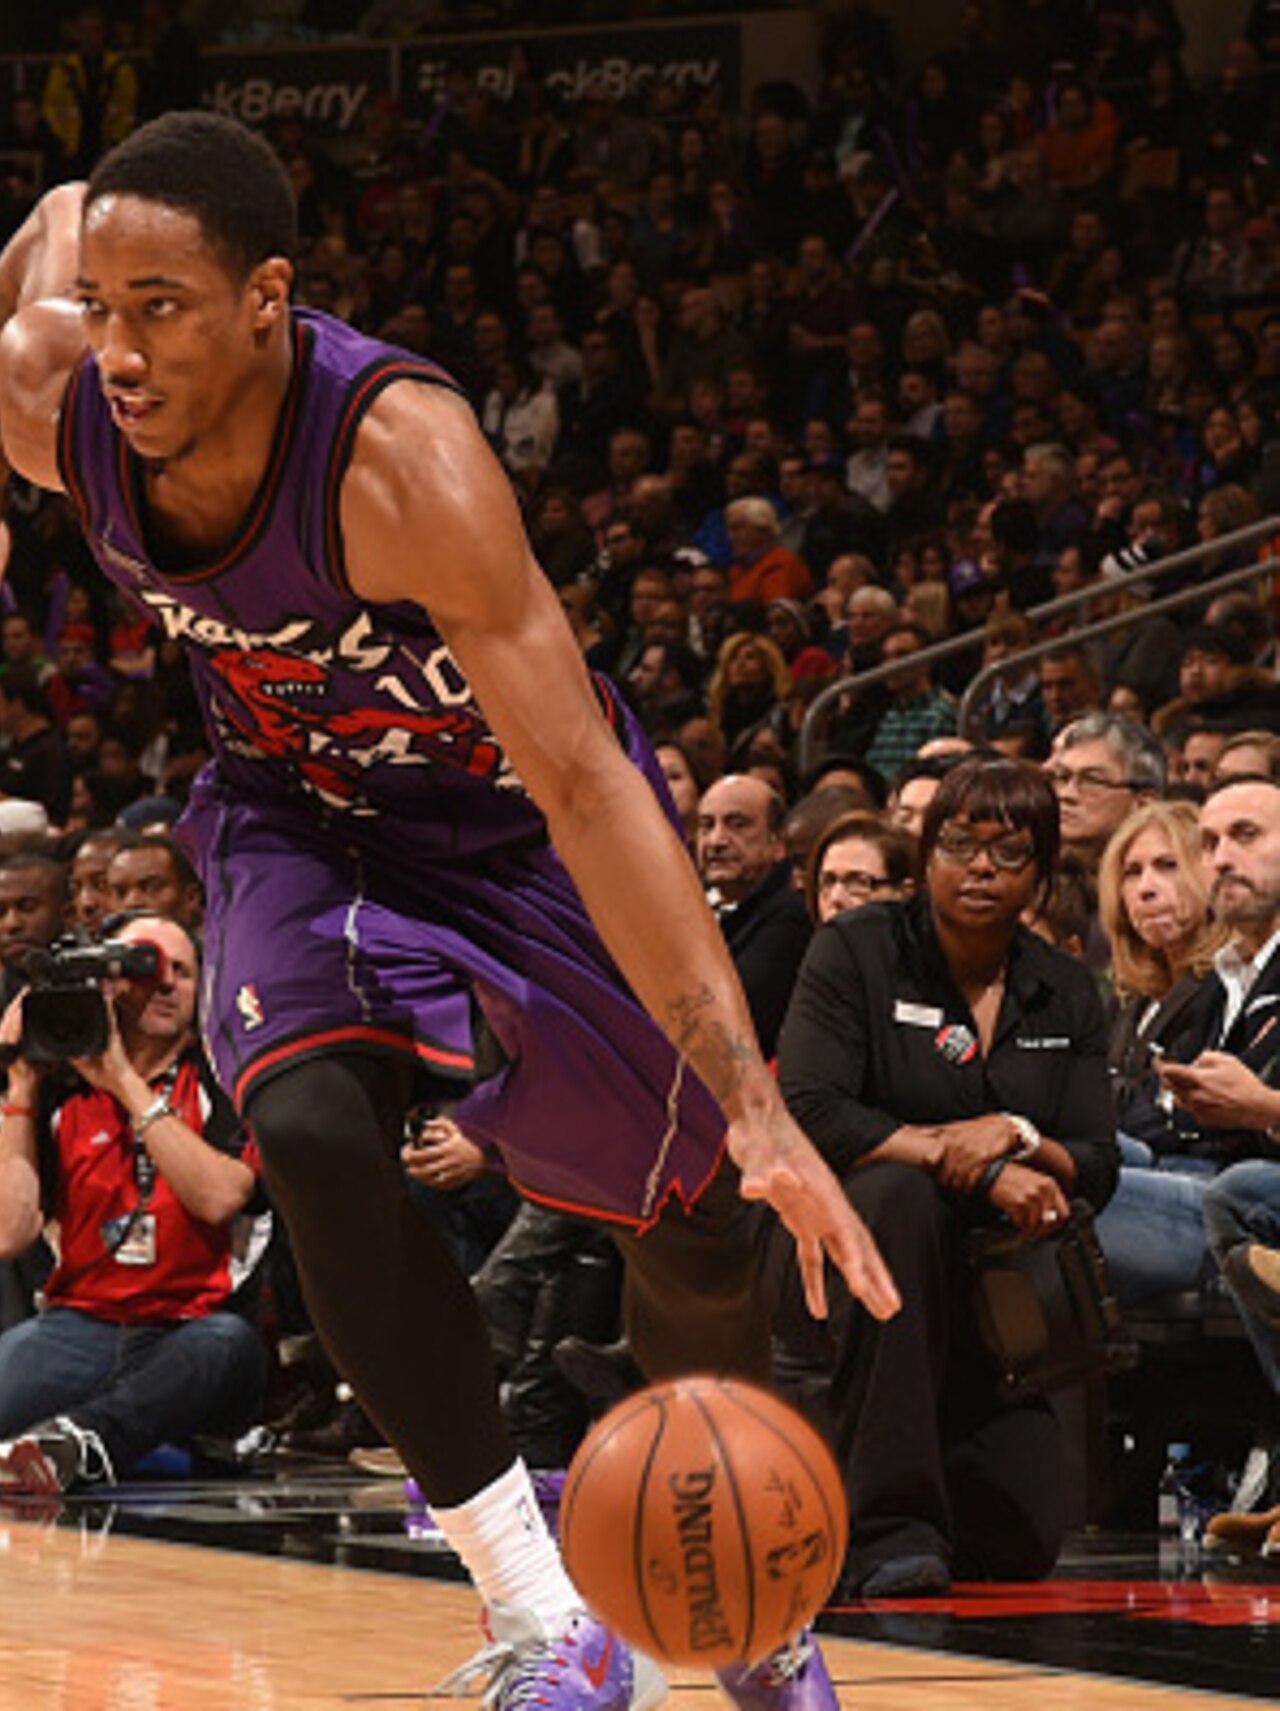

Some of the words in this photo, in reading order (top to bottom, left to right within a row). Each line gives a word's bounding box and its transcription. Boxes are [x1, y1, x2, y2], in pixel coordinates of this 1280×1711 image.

[202, 78, 368, 129] kBerry
[476, 57, 720, 101] BlckBerry
[373, 644, 473, 711] 10
[669, 1459, 734, 1651] SPALDING
